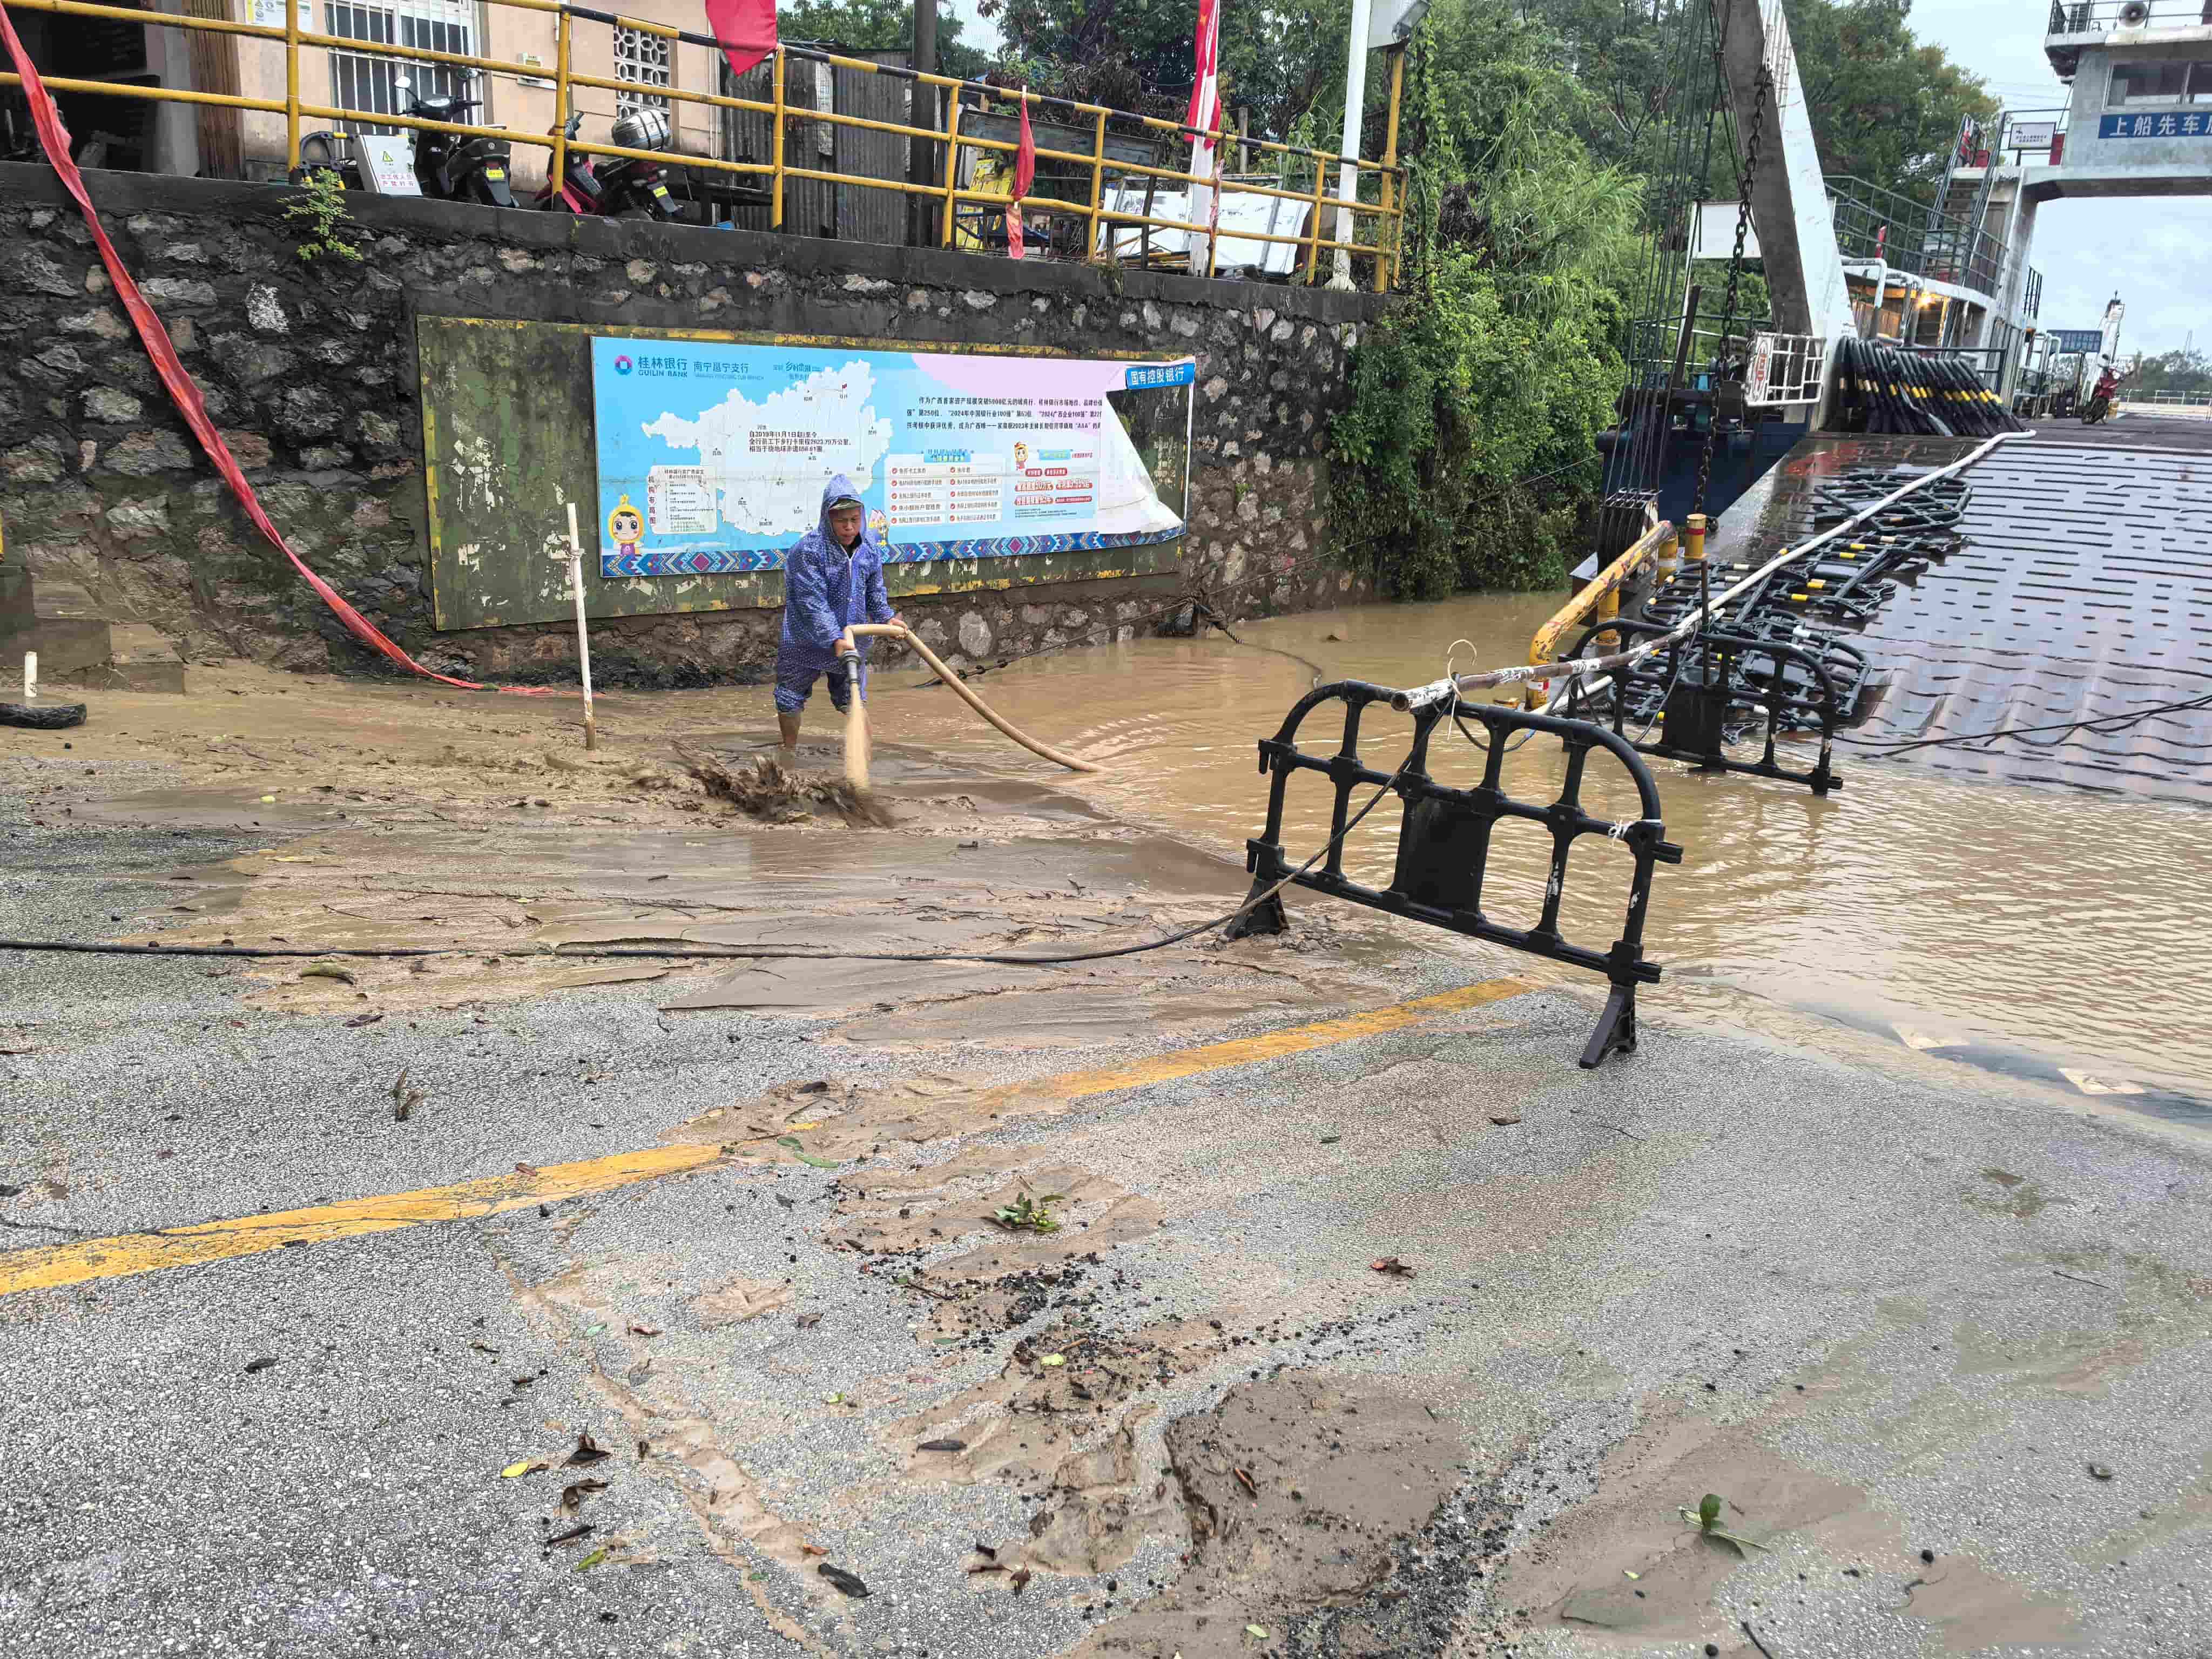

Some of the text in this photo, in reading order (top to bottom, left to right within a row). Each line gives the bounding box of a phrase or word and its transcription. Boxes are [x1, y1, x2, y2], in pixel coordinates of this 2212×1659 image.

[638, 356, 687, 370] 桂林银行
[1131, 367, 1184, 385] 国有控股银行
